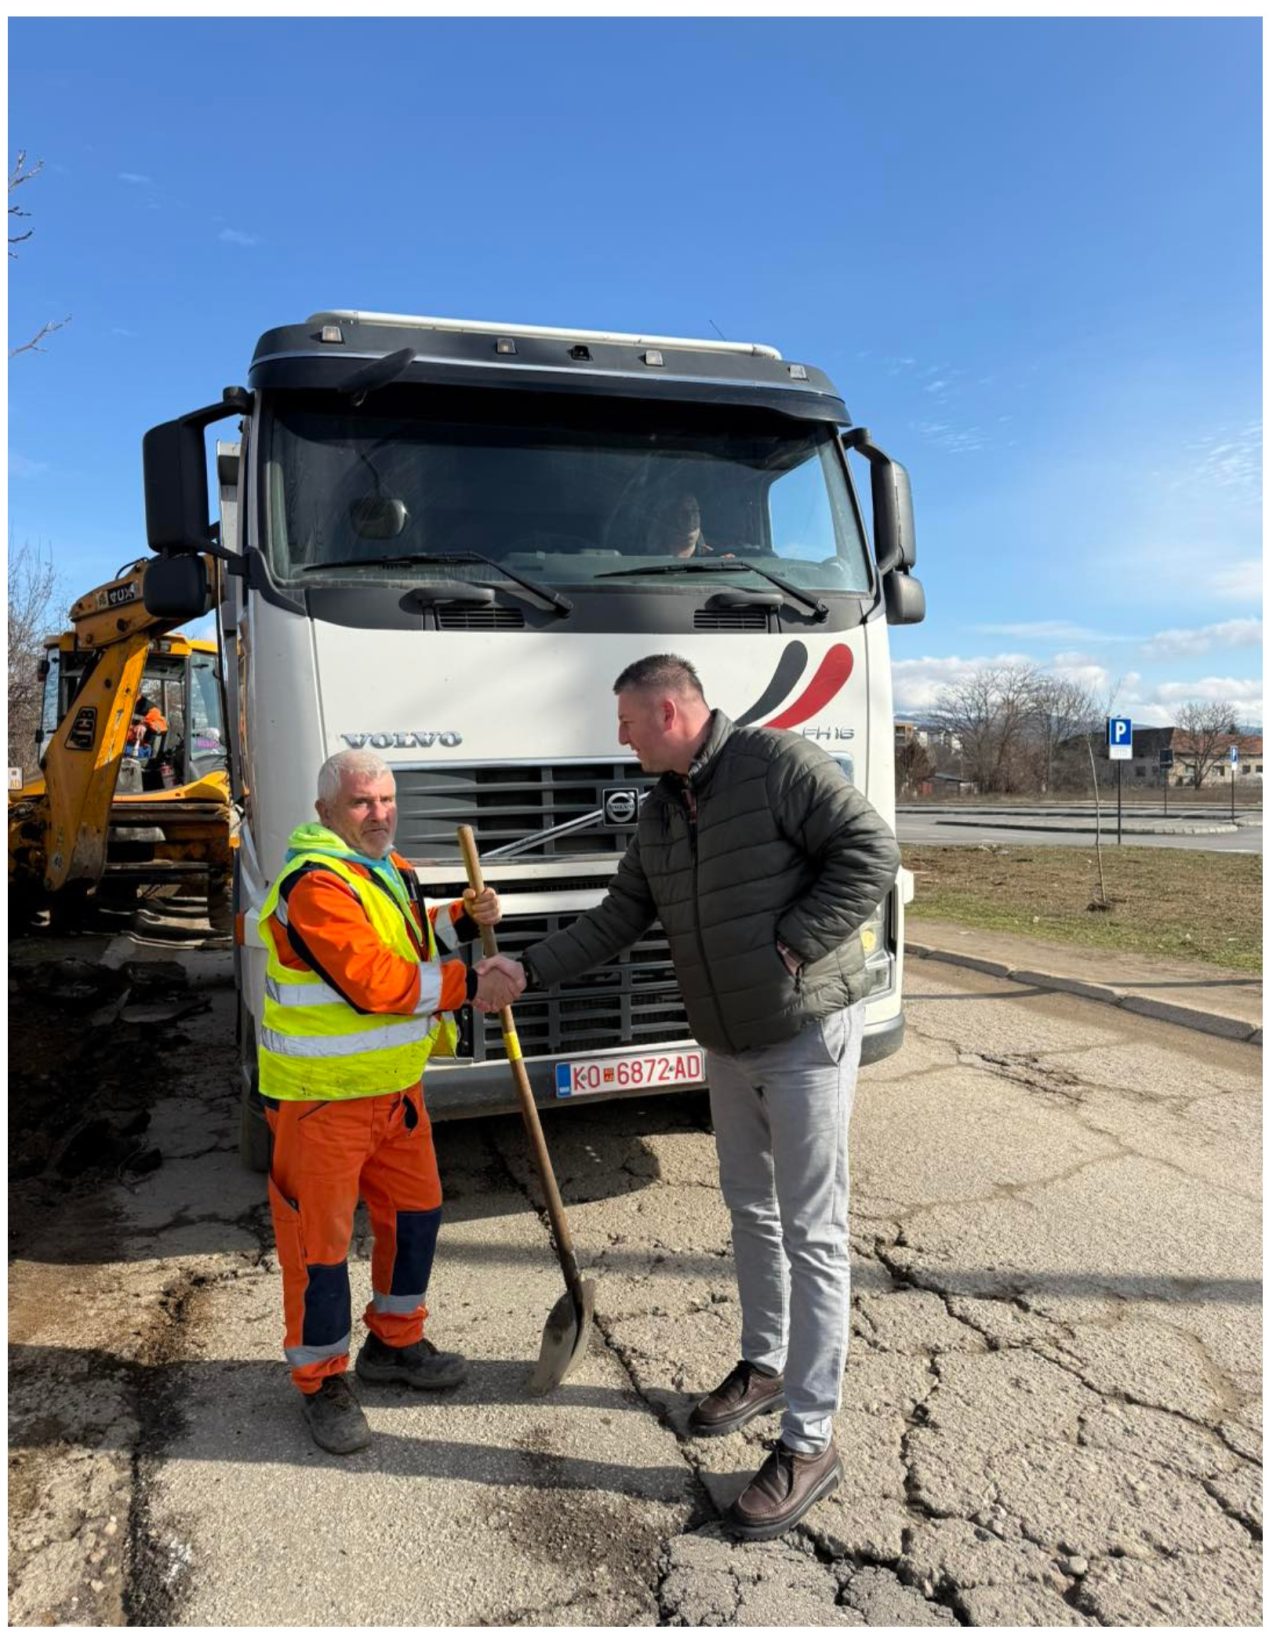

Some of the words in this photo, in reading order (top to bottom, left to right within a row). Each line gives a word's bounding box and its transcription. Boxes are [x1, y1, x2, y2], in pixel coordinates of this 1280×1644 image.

[340, 730, 463, 749] VOLVO
[802, 726, 855, 740] FH16
[1115, 721, 1127, 743] P
[573, 1065, 600, 1090] KO
